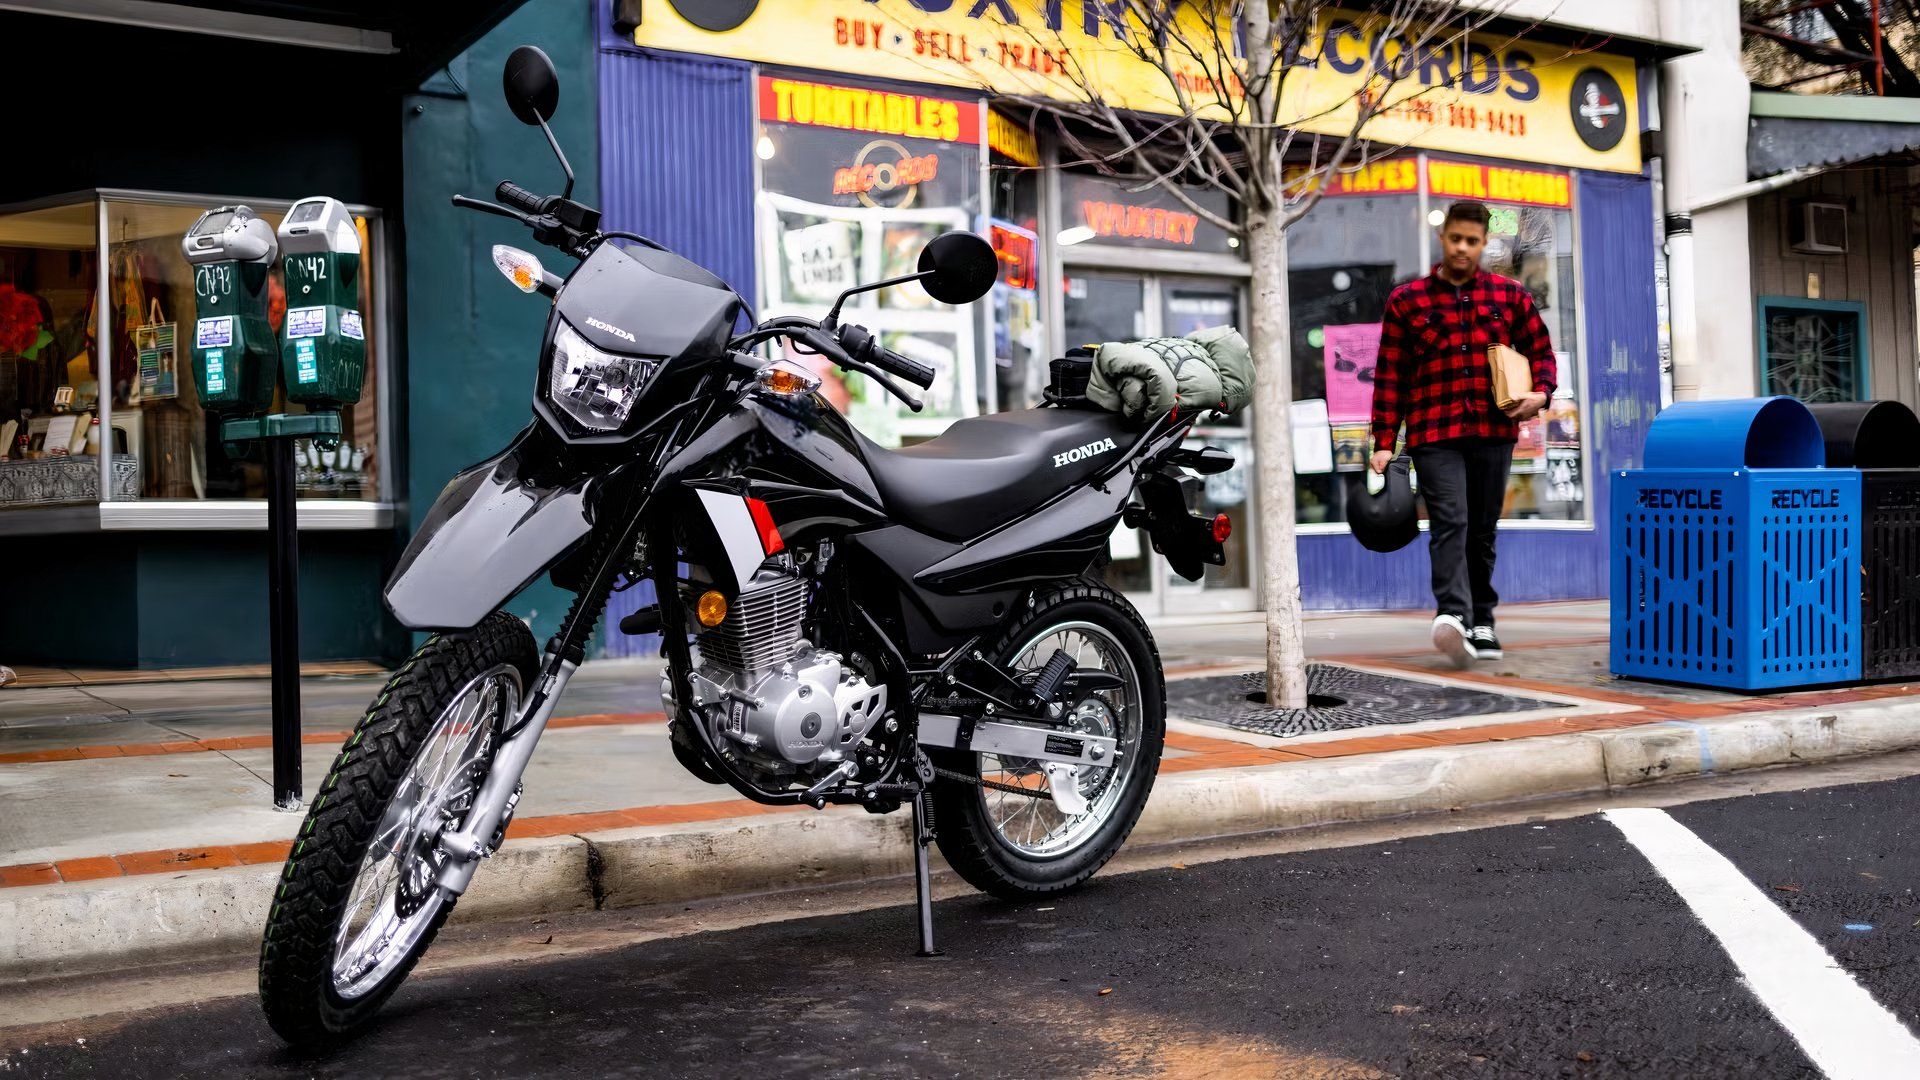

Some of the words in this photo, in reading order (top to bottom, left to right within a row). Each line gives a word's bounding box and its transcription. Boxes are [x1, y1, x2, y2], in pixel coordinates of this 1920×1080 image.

[834, 17, 883, 49] BUY
[913, 28, 972, 63] SELL
[772, 79, 959, 141] TURNTABLES
[833, 154, 938, 195] RECORDS
[1340, 157, 1417, 193] TAPES
[1427, 160, 1486, 198] VINYL
[1084, 200, 1199, 245] WUXTRY
[585, 316, 636, 343] HONDA
[1052, 437, 1118, 468] HONDA
[1637, 488, 1722, 510] RECYCLE
[1771, 488, 1840, 509] RECYCLE
